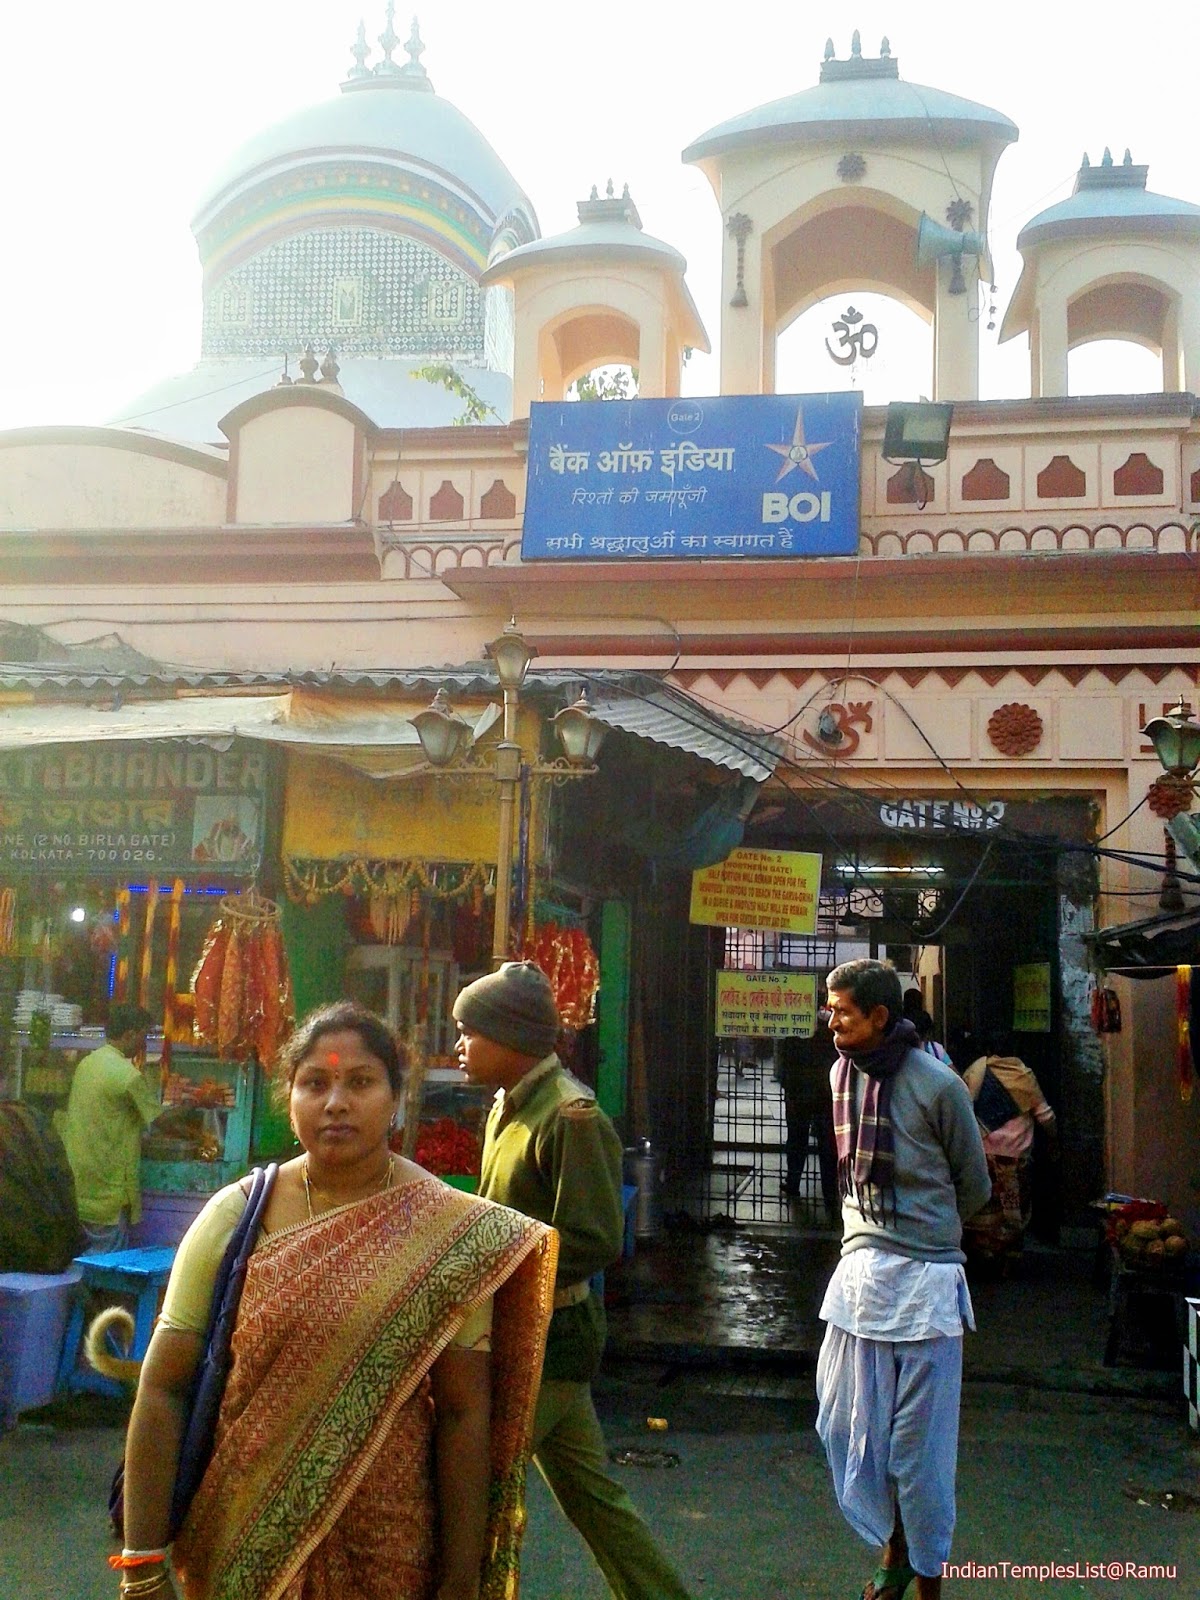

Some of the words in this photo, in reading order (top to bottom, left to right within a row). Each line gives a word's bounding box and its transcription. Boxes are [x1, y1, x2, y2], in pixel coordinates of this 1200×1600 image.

[671, 413, 693, 421] Gate
[549, 444, 590, 474] बैंक
[660, 441, 735, 477] इंडिया
[572, 487, 614, 506] रिश्तों
[618, 487, 639, 505] की
[762, 491, 831, 524] BOI
[546, 533, 584, 549] सभी
[589, 530, 675, 553] श्रद्धालुओं
[681, 535, 707, 548] का
[713, 534, 775, 549] स्वागत
[778, 528, 794, 549] हैं
[880, 800, 950, 829] GATE
[79, 834, 126, 846] BIRLA
[130, 833, 176, 846] GATE)
[737, 852, 758, 860] GATE
[724, 862, 768, 871] (NORTHERN
[769, 866, 793, 874] GATE)
[773, 876, 786, 886] OPEN
[787, 877, 797, 887] FOR
[797, 878, 807, 888] THE
